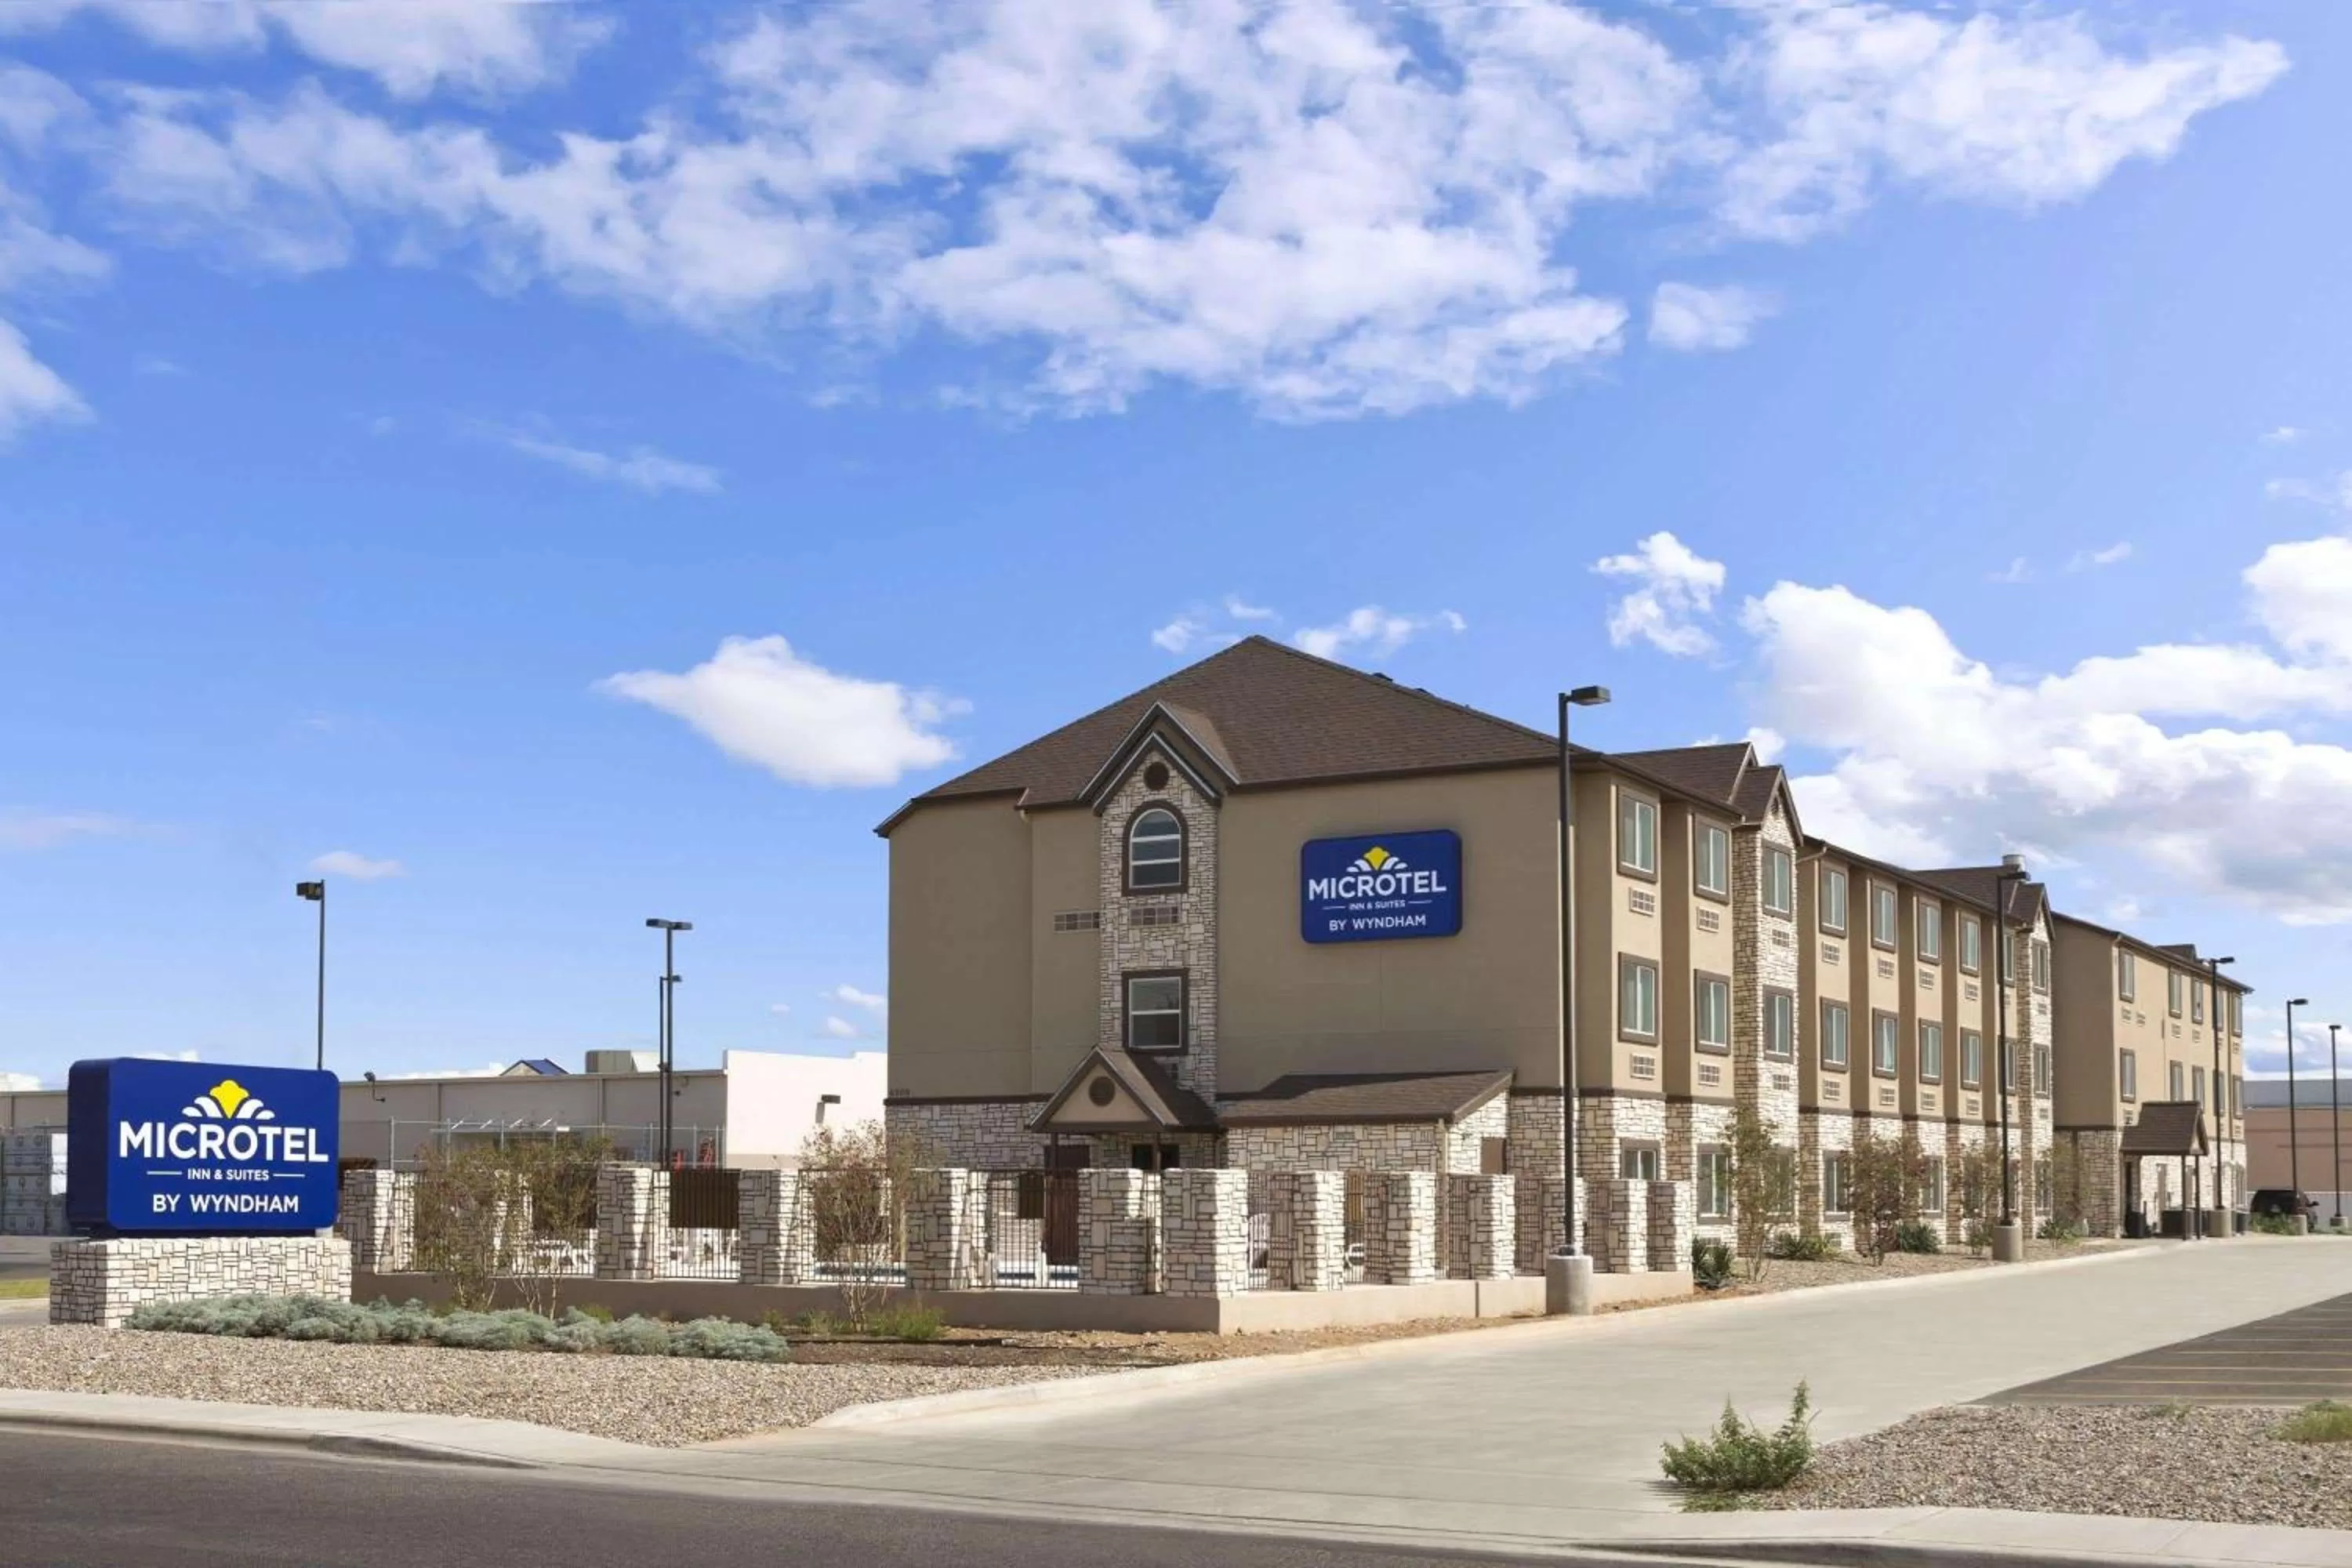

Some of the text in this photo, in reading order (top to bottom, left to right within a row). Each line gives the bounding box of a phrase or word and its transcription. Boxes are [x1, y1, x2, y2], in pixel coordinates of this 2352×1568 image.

[1308, 870, 1446, 901] MICROTEL
[1374, 900, 1406, 909] SUITES
[1330, 915, 1426, 931] BY WYNDHAM
[119, 1120, 329, 1163] MICROTEL
[187, 1168, 270, 1181] INN & SUITES
[153, 1194, 299, 1213] BY WYNDHAM
